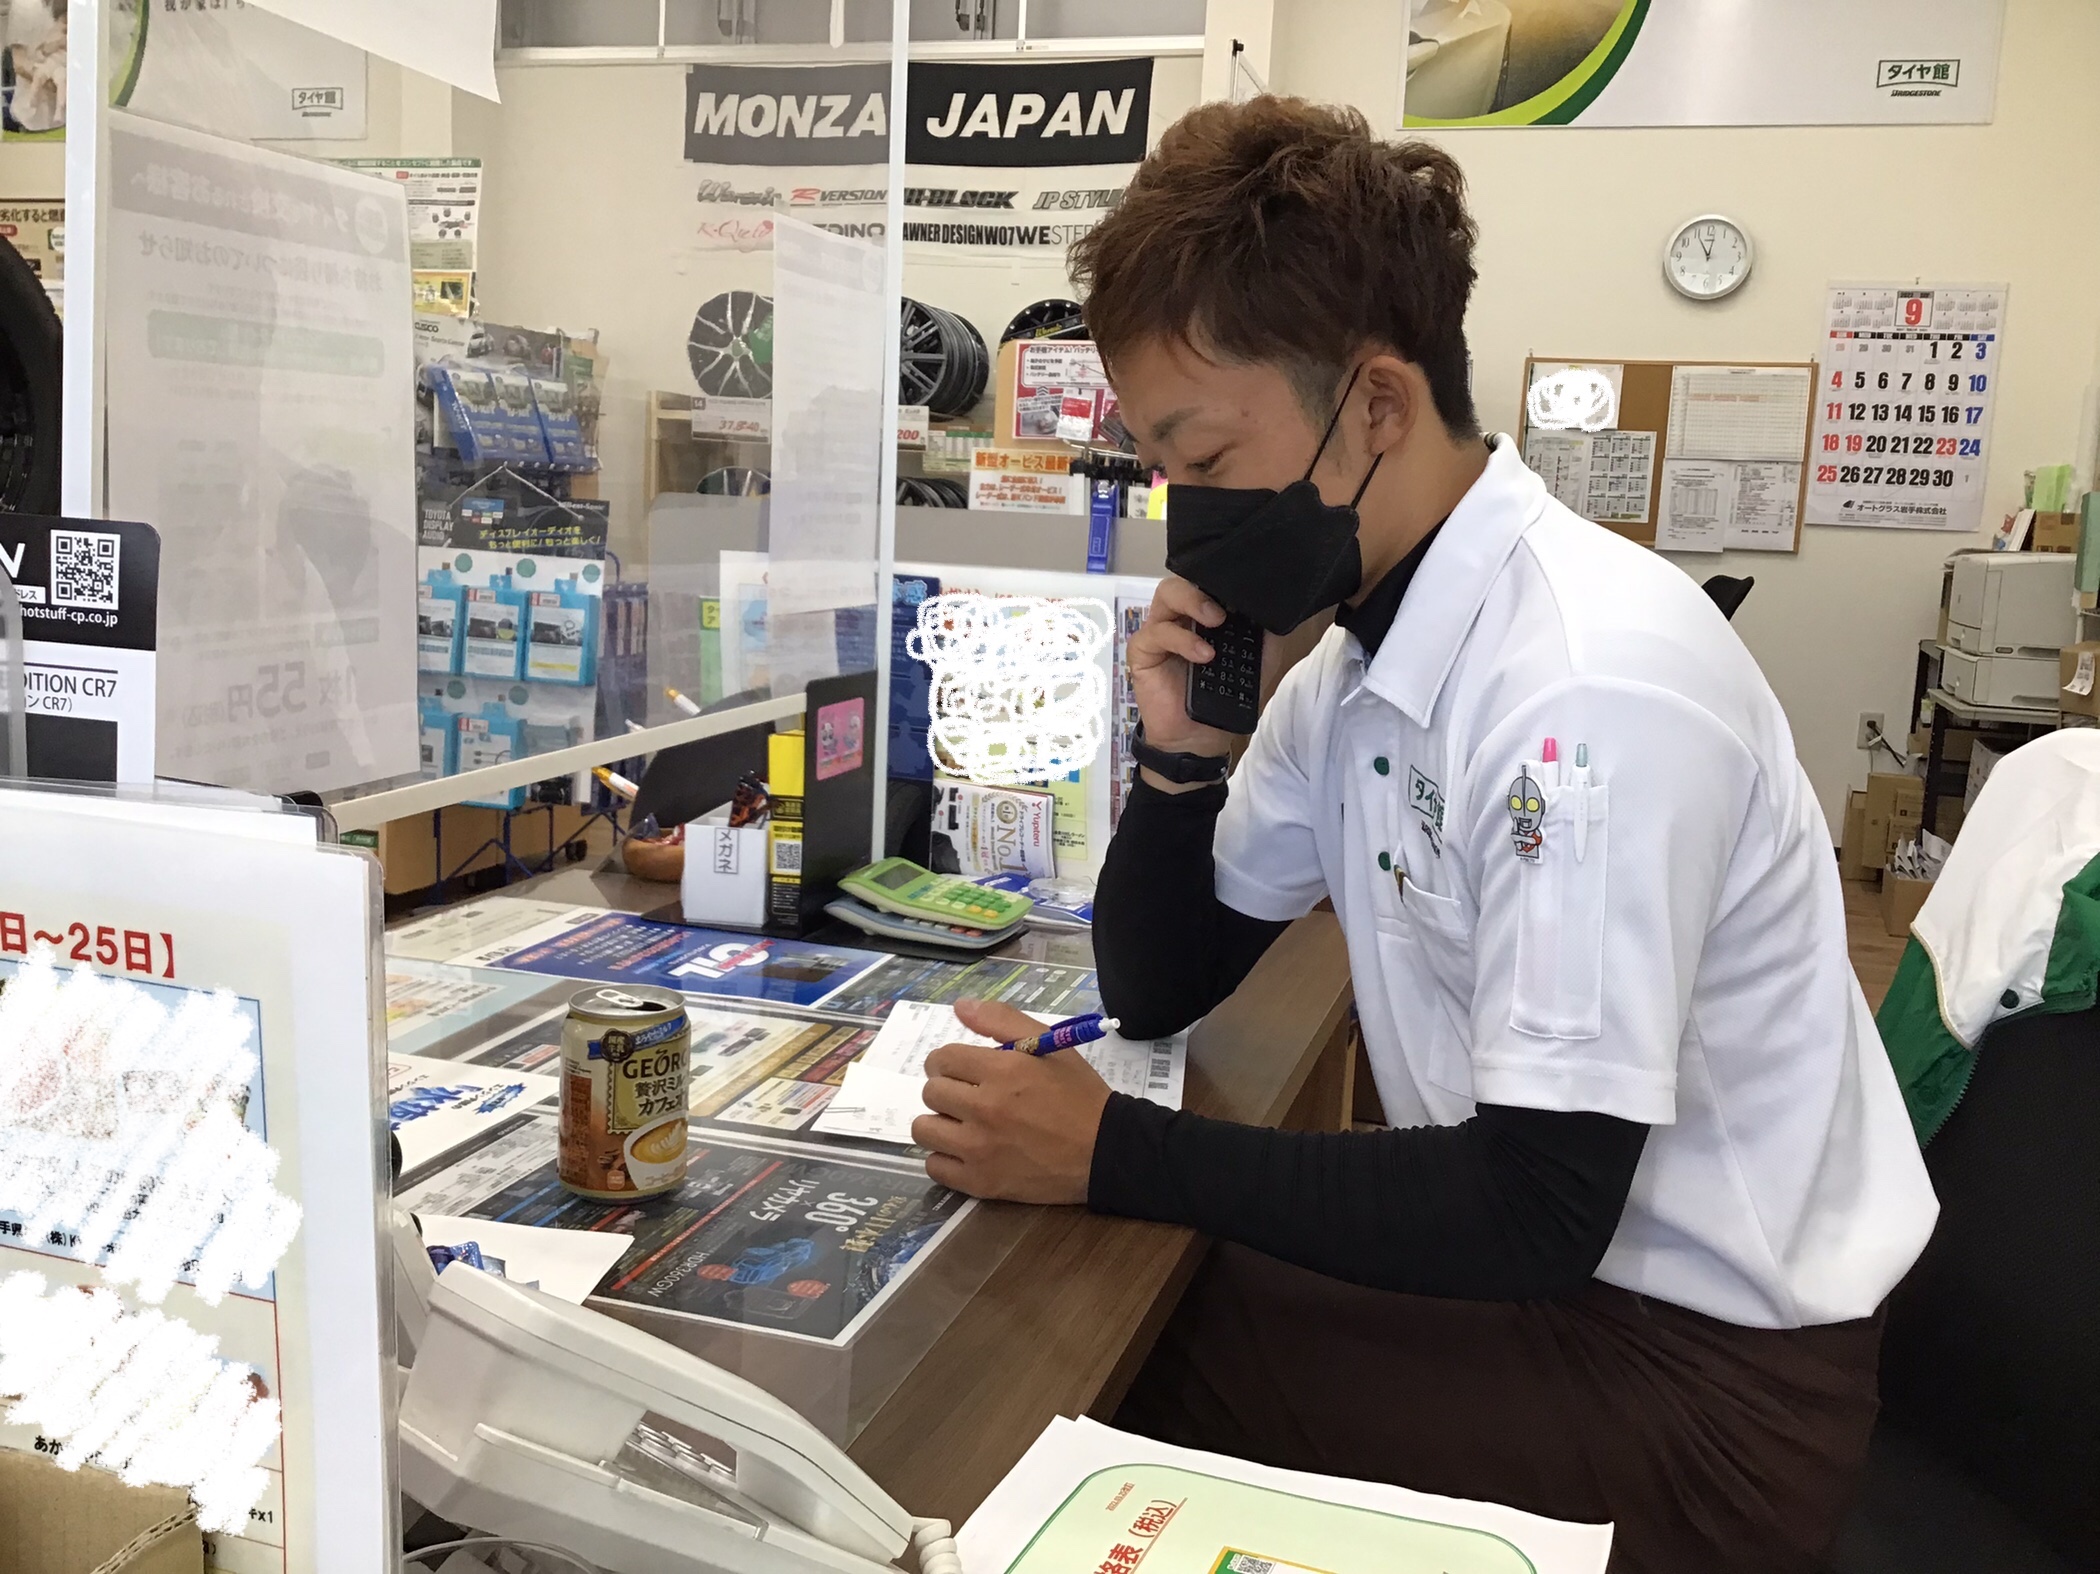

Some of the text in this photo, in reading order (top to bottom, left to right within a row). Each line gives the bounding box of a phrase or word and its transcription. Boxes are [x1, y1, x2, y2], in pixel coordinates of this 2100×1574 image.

[1888, 64, 1950, 80] タイヤ館
[693, 88, 1136, 139] MONZA JAPAN
[819, 190, 888, 201] VERSION
[1032, 191, 1060, 209] JP
[942, 224, 983, 245] DESIGN
[984, 226, 1014, 246] W07
[1707, 225, 1715, 236] 12
[1731, 237, 1738, 248] 2
[1676, 251, 1682, 262] 9
[1904, 298, 1923, 326] 9
[1930, 342, 1938, 358] 1
[1951, 342, 1962, 359] 2
[1975, 343, 1987, 359] 3
[1831, 371, 1987, 392] 4 5 6 7 8 9 10
[1827, 403, 1983, 424] 11 12 13 14 15 16 17
[1822, 434, 1981, 456] 18 19 20 21 22 23 24
[975, 452, 1077, 471] 新型オービス最新
[1817, 465, 1837, 482] 25
[1840, 466, 1860, 483] 26
[1863, 467, 1883, 484] 27
[1886, 468, 1906, 485] 28
[1909, 469, 1930, 486] 29
[1932, 470, 1953, 487] 30
[424, 509, 450, 520] TOYOTA
[1857, 503, 1947, 515] オートグラス岩手株式会社
[422, 531, 445, 541] AUDIO
[423, 521, 454, 532] DISPLAY
[479, 526, 582, 538] ディスプレイオーディオを
[82, 677, 117, 698] CR7
[42, 695, 72, 712] CR7)
[1031, 812, 1041, 847] Yupiteru
[718, 830, 733, 873] メガネ
[997, 825, 1028, 872] No.1
[668, 942, 771, 979] OIL
[750, 1179, 820, 1222] リヤカメラ
[804, 1191, 878, 1233] 360°
[647, 1250, 710, 1298] HDR360GW
